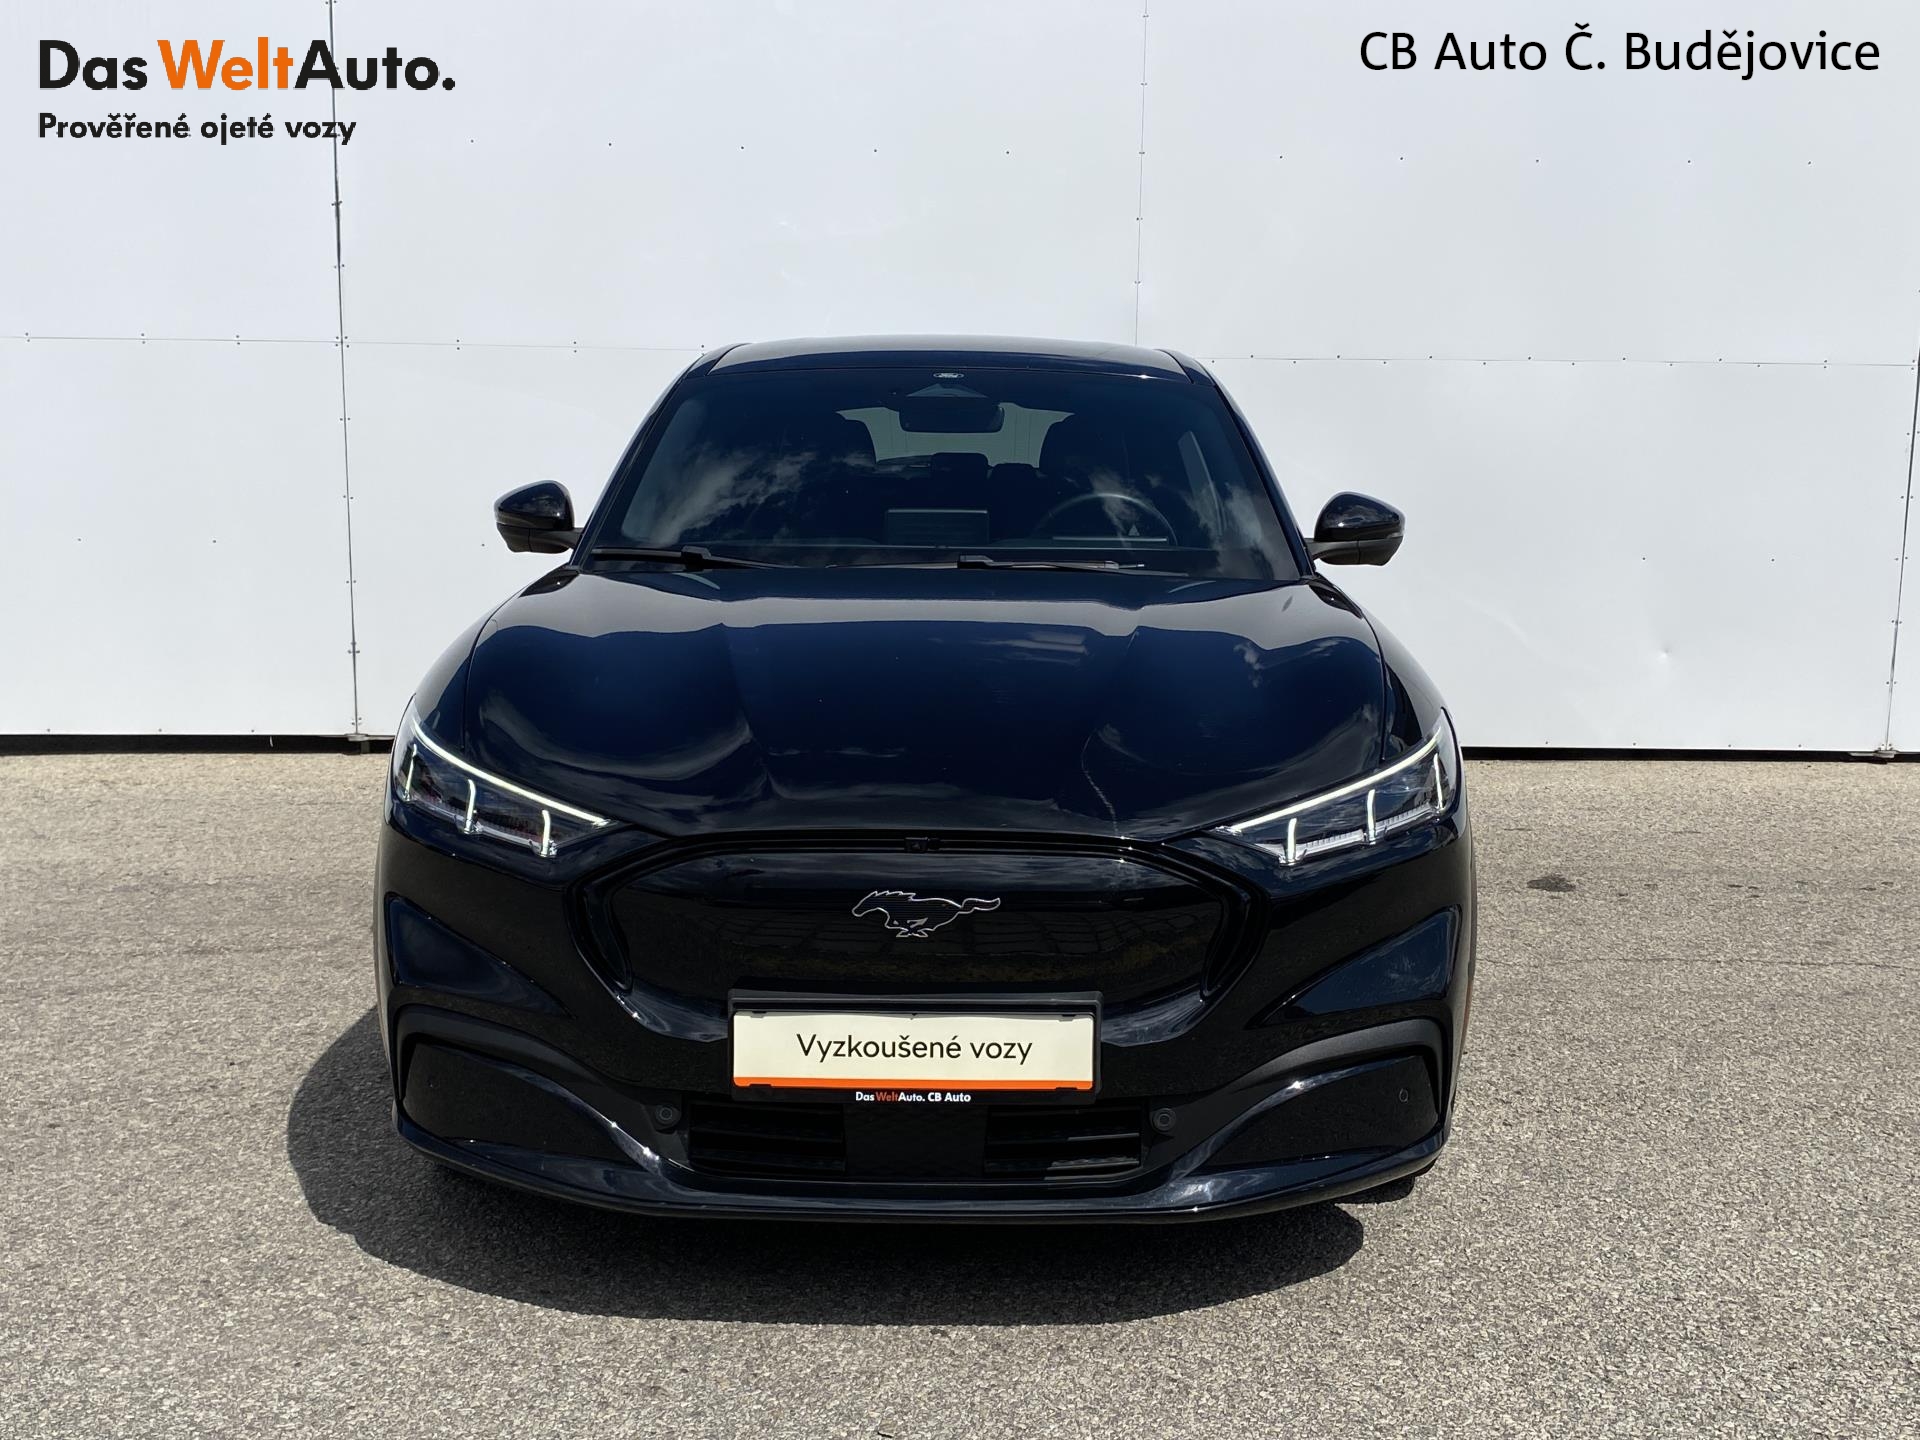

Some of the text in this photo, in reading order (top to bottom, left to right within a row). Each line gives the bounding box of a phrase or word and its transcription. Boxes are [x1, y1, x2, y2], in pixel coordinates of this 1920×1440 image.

[797, 1033, 1033, 1064] Vyzkoušené vozy
[855, 1091, 875, 1101] Das
[927, 1092, 942, 1102] CB
[944, 1092, 972, 1103] Auto
